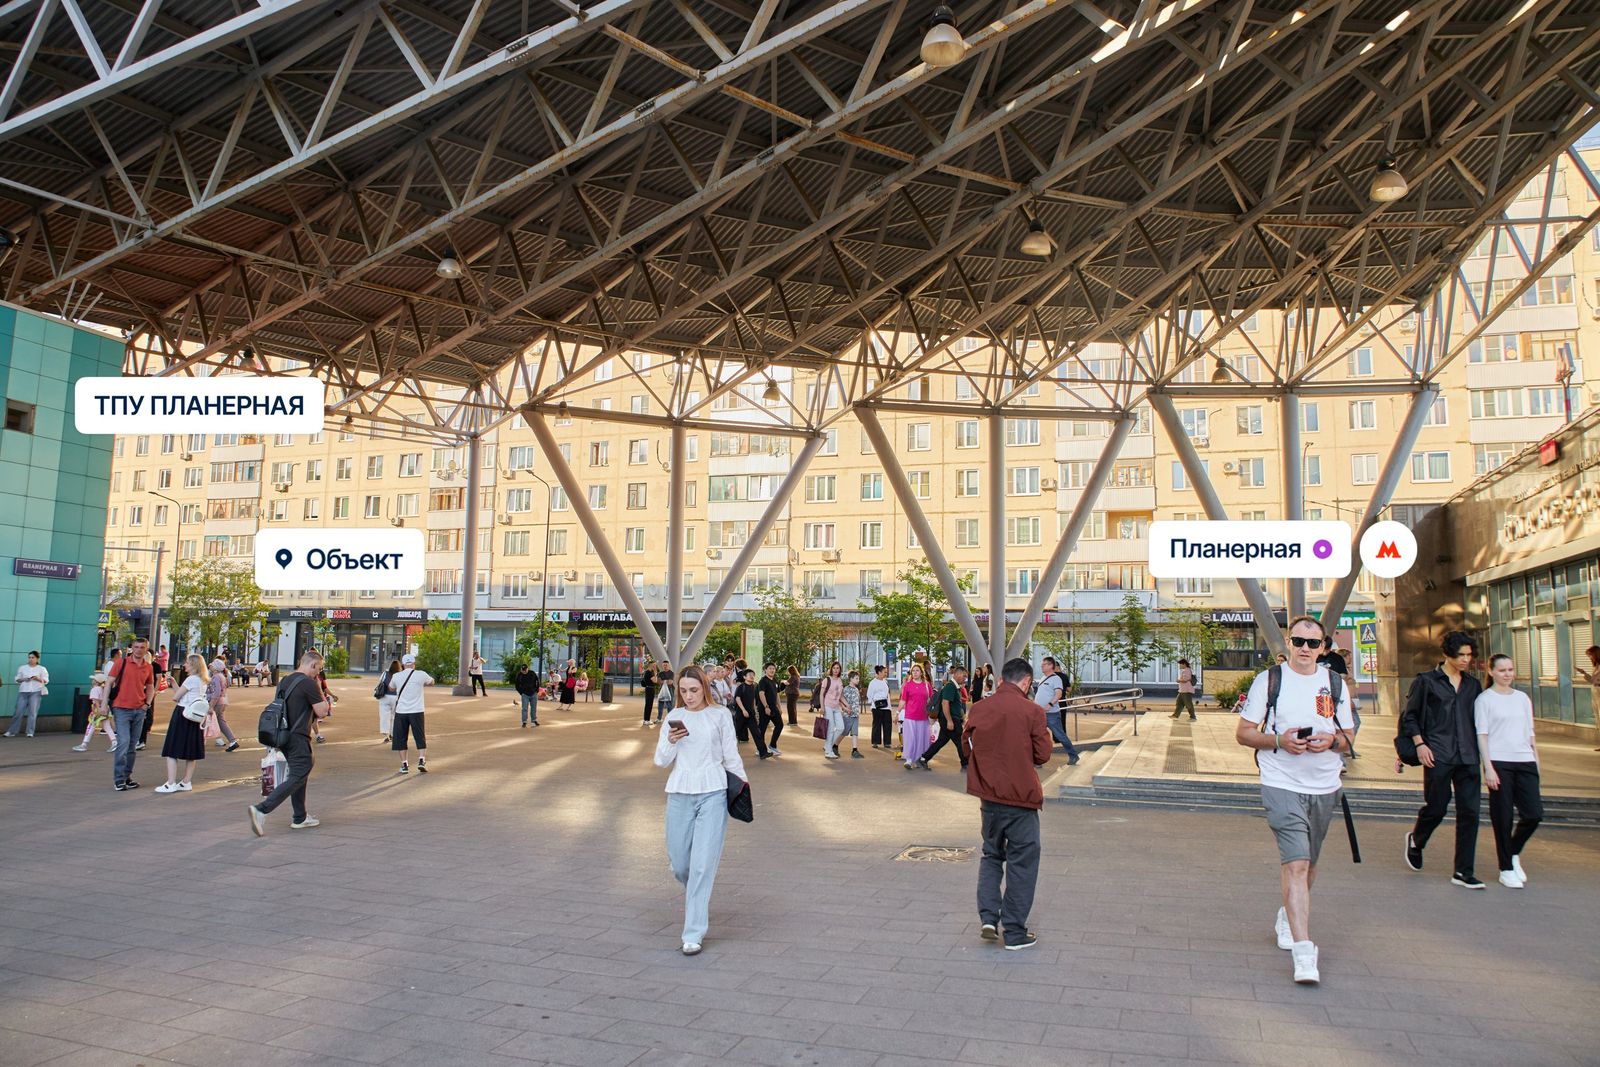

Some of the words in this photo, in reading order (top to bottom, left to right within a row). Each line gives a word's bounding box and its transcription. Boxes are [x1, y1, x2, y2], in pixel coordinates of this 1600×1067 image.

[22, 563, 58, 571] ПЛАНЕРНАЯ
[67, 567, 73, 575] 7
[583, 613, 606, 621] КИНГ
[609, 613, 633, 621] ТАБА
[1212, 613, 1254, 622] LAVAШ
